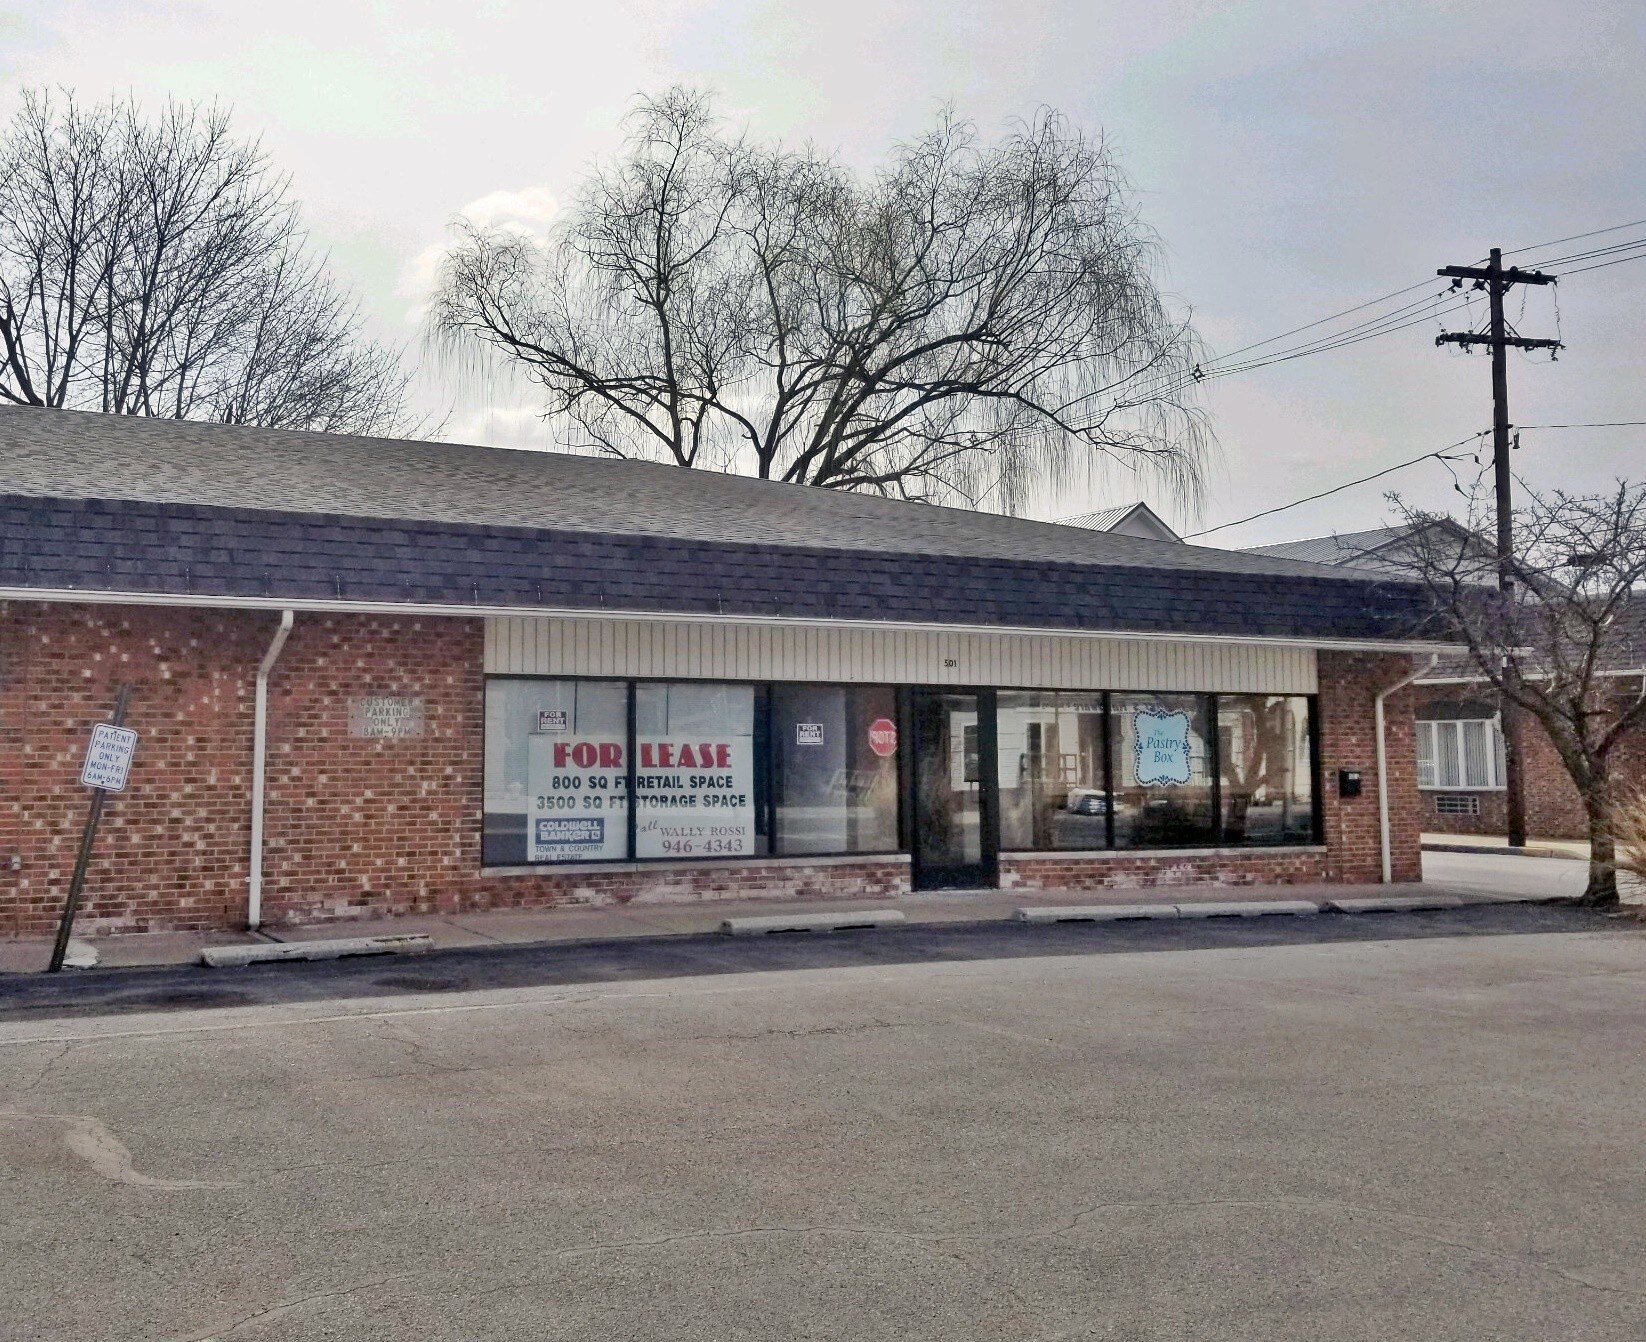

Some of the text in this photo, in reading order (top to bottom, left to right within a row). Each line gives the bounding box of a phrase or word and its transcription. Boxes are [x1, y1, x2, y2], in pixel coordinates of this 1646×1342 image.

[944, 659, 957, 668] 501
[360, 697, 414, 707] CUSTOMER
[365, 707, 410, 717] PARKING
[373, 717, 401, 727] ONLY
[98, 730, 132, 744] PATIENT
[363, 727, 411, 737] 8AM-9PM
[800, 730, 821, 738] RENT
[94, 740, 130, 755] PARKING
[1146, 736, 1182, 752] Pastry
[98, 752, 120, 763] ONLY
[553, 742, 732, 769] FOR LEASE
[1153, 750, 1173, 763] Box
[90, 760, 124, 775] MON-FRI
[87, 772, 122, 785] 6AM-6PM
[552, 775, 582, 790] 800
[588, 775, 608, 790] SQ
[636, 775, 684, 789] RETAIL
[689, 775, 734, 789] SPACE
[537, 795, 576, 810] 3500
[582, 795, 603, 809] SQ
[609, 795, 626, 809] FT
[702, 794, 746, 808] SPACE
[540, 820, 600, 831] COLDWELL
[636, 819, 746, 837] all WALLY ROSSI
[540, 830, 590, 841] BANKER
[535, 844, 604, 853] TOWN & COUNTRY
[662, 838, 743, 854] 946-4343
[534, 853, 583, 861] REAL ESTATE
